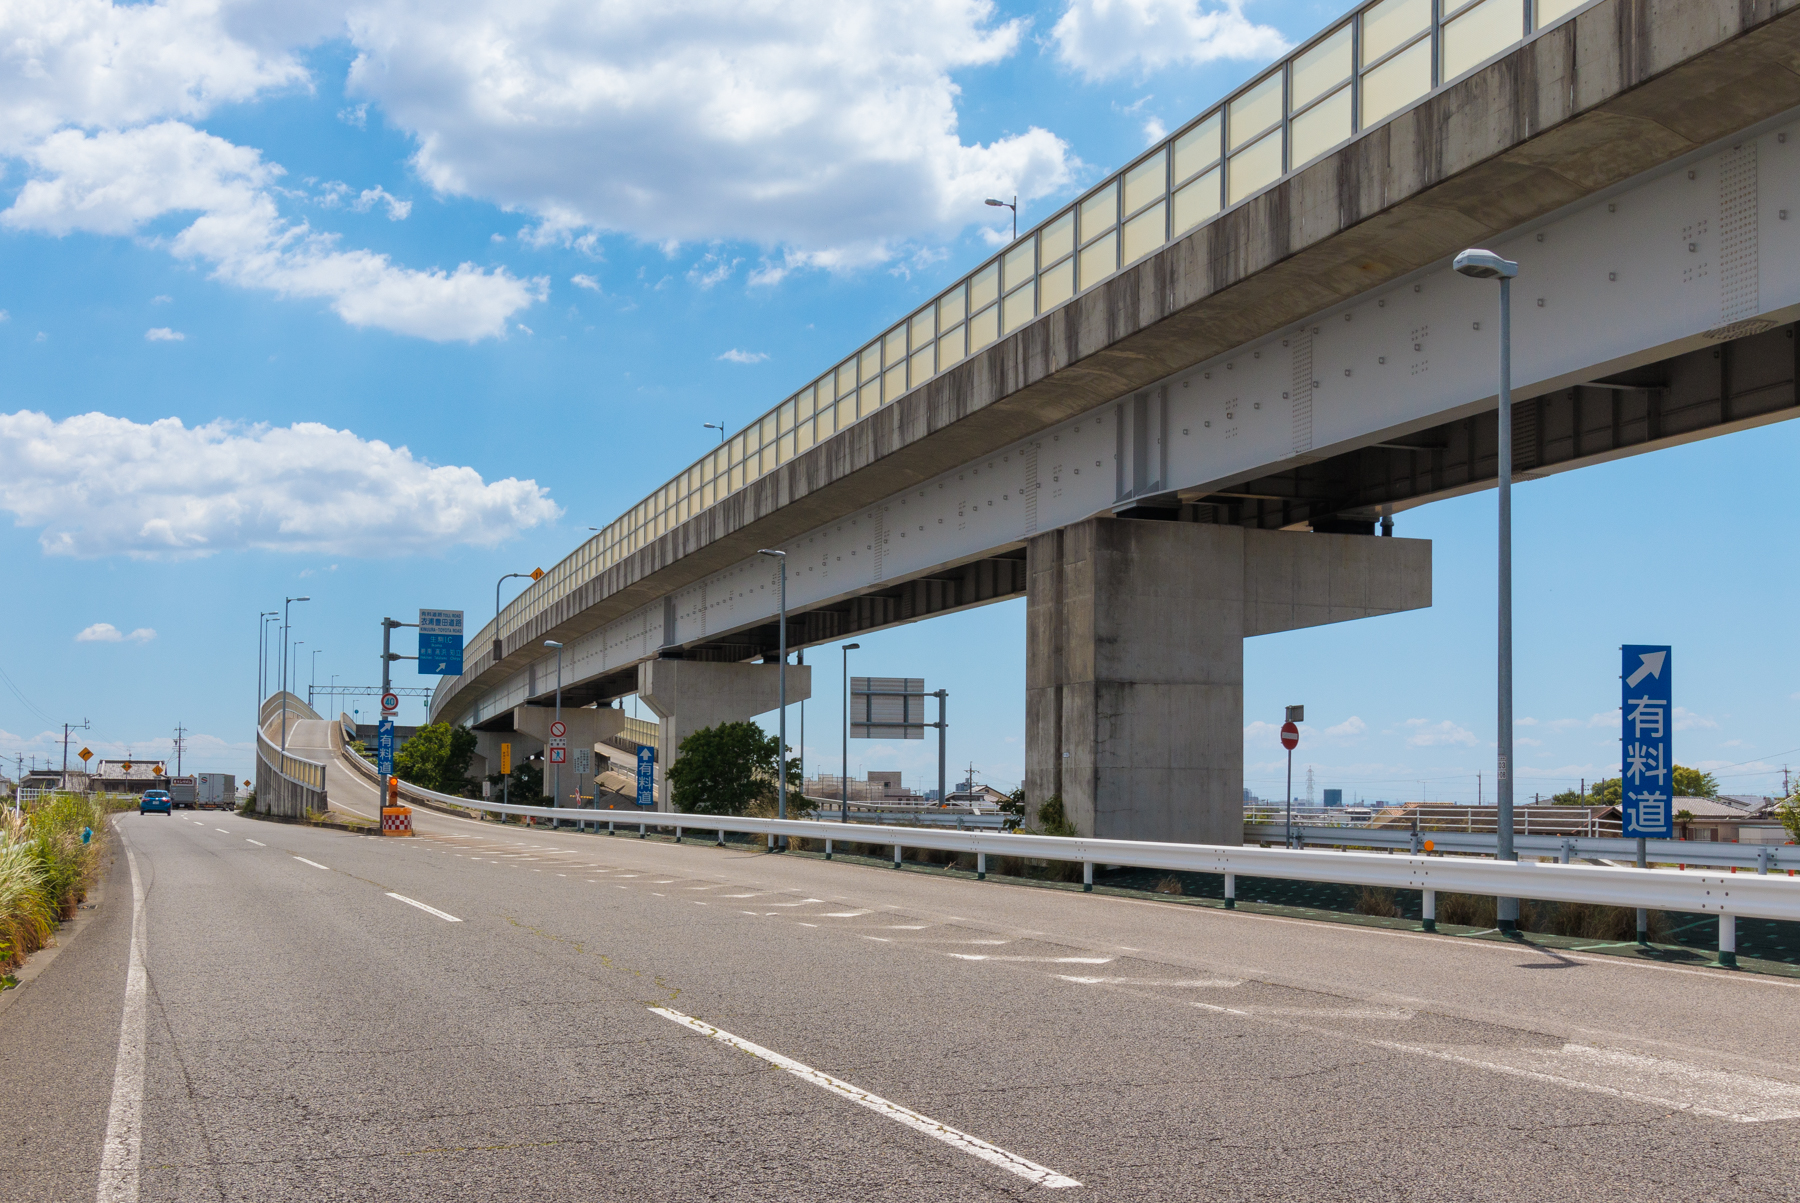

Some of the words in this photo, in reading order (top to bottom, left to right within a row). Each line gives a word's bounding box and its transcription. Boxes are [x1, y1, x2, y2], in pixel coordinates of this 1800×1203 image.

[421, 618, 462, 627] 衣浦豊田道路
[384, 697, 395, 706] 40
[380, 734, 393, 774] 有料道
[1627, 695, 1667, 832] 有料道
[639, 761, 652, 804] 有料道
